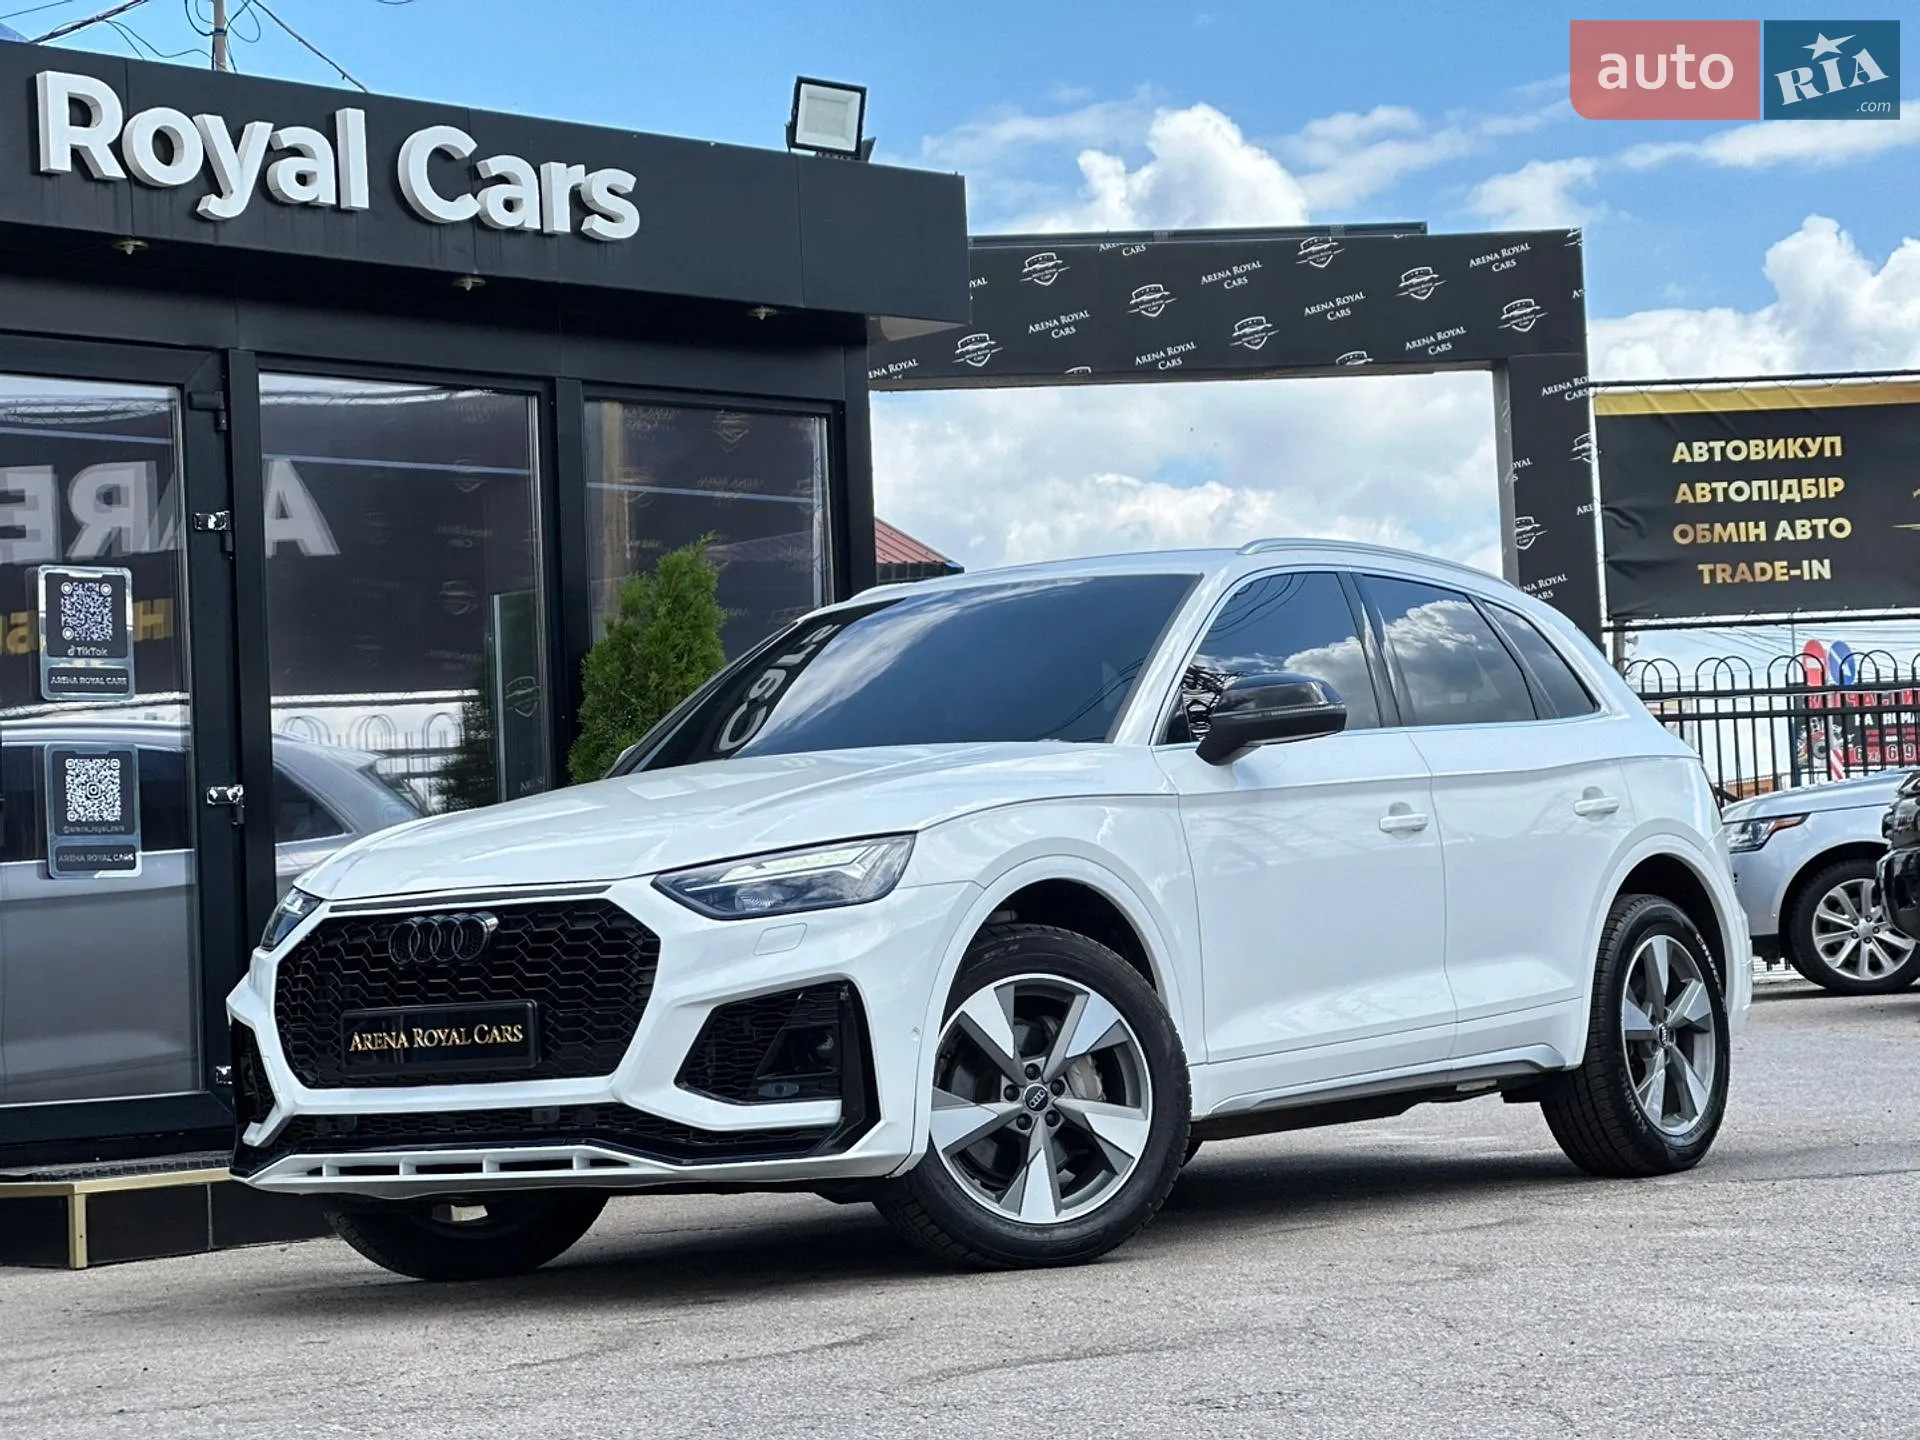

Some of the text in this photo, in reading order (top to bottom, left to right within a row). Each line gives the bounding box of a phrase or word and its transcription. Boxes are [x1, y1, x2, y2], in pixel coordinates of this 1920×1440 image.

[35, 70, 641, 241] Royal Cars
[1469, 242, 1531, 268] ARENA ROYAL
[1492, 258, 1517, 272] CARS
[1201, 260, 1262, 285] ARENA ROYAL
[1223, 275, 1248, 289] CARS
[1304, 291, 1366, 317] ARENA ROYAL
[1327, 307, 1351, 321] CARS
[1029, 309, 1090, 334] ARENA ROYAL
[1051, 325, 1076, 339] CARS
[1405, 325, 1467, 351] ARENA ROYAL
[1428, 341, 1452, 355] CARS
[887, 358, 920, 373] ROYAL
[1135, 341, 1197, 366] ARENA ROYAL
[1158, 356, 1183, 370] CARS
[1541, 381, 1573, 397] ARENA
[1672, 435, 1843, 464] АВТОВИКУП
[1675, 477, 1845, 504] АВТОПІДБІР
[1672, 517, 1853, 546] ОБМІН АВТО
[1537, 573, 1568, 589] ROYAL
[1698, 558, 1832, 584] TRADE-IN
[349, 1023, 524, 1052] ARENA ROYAL CARS
